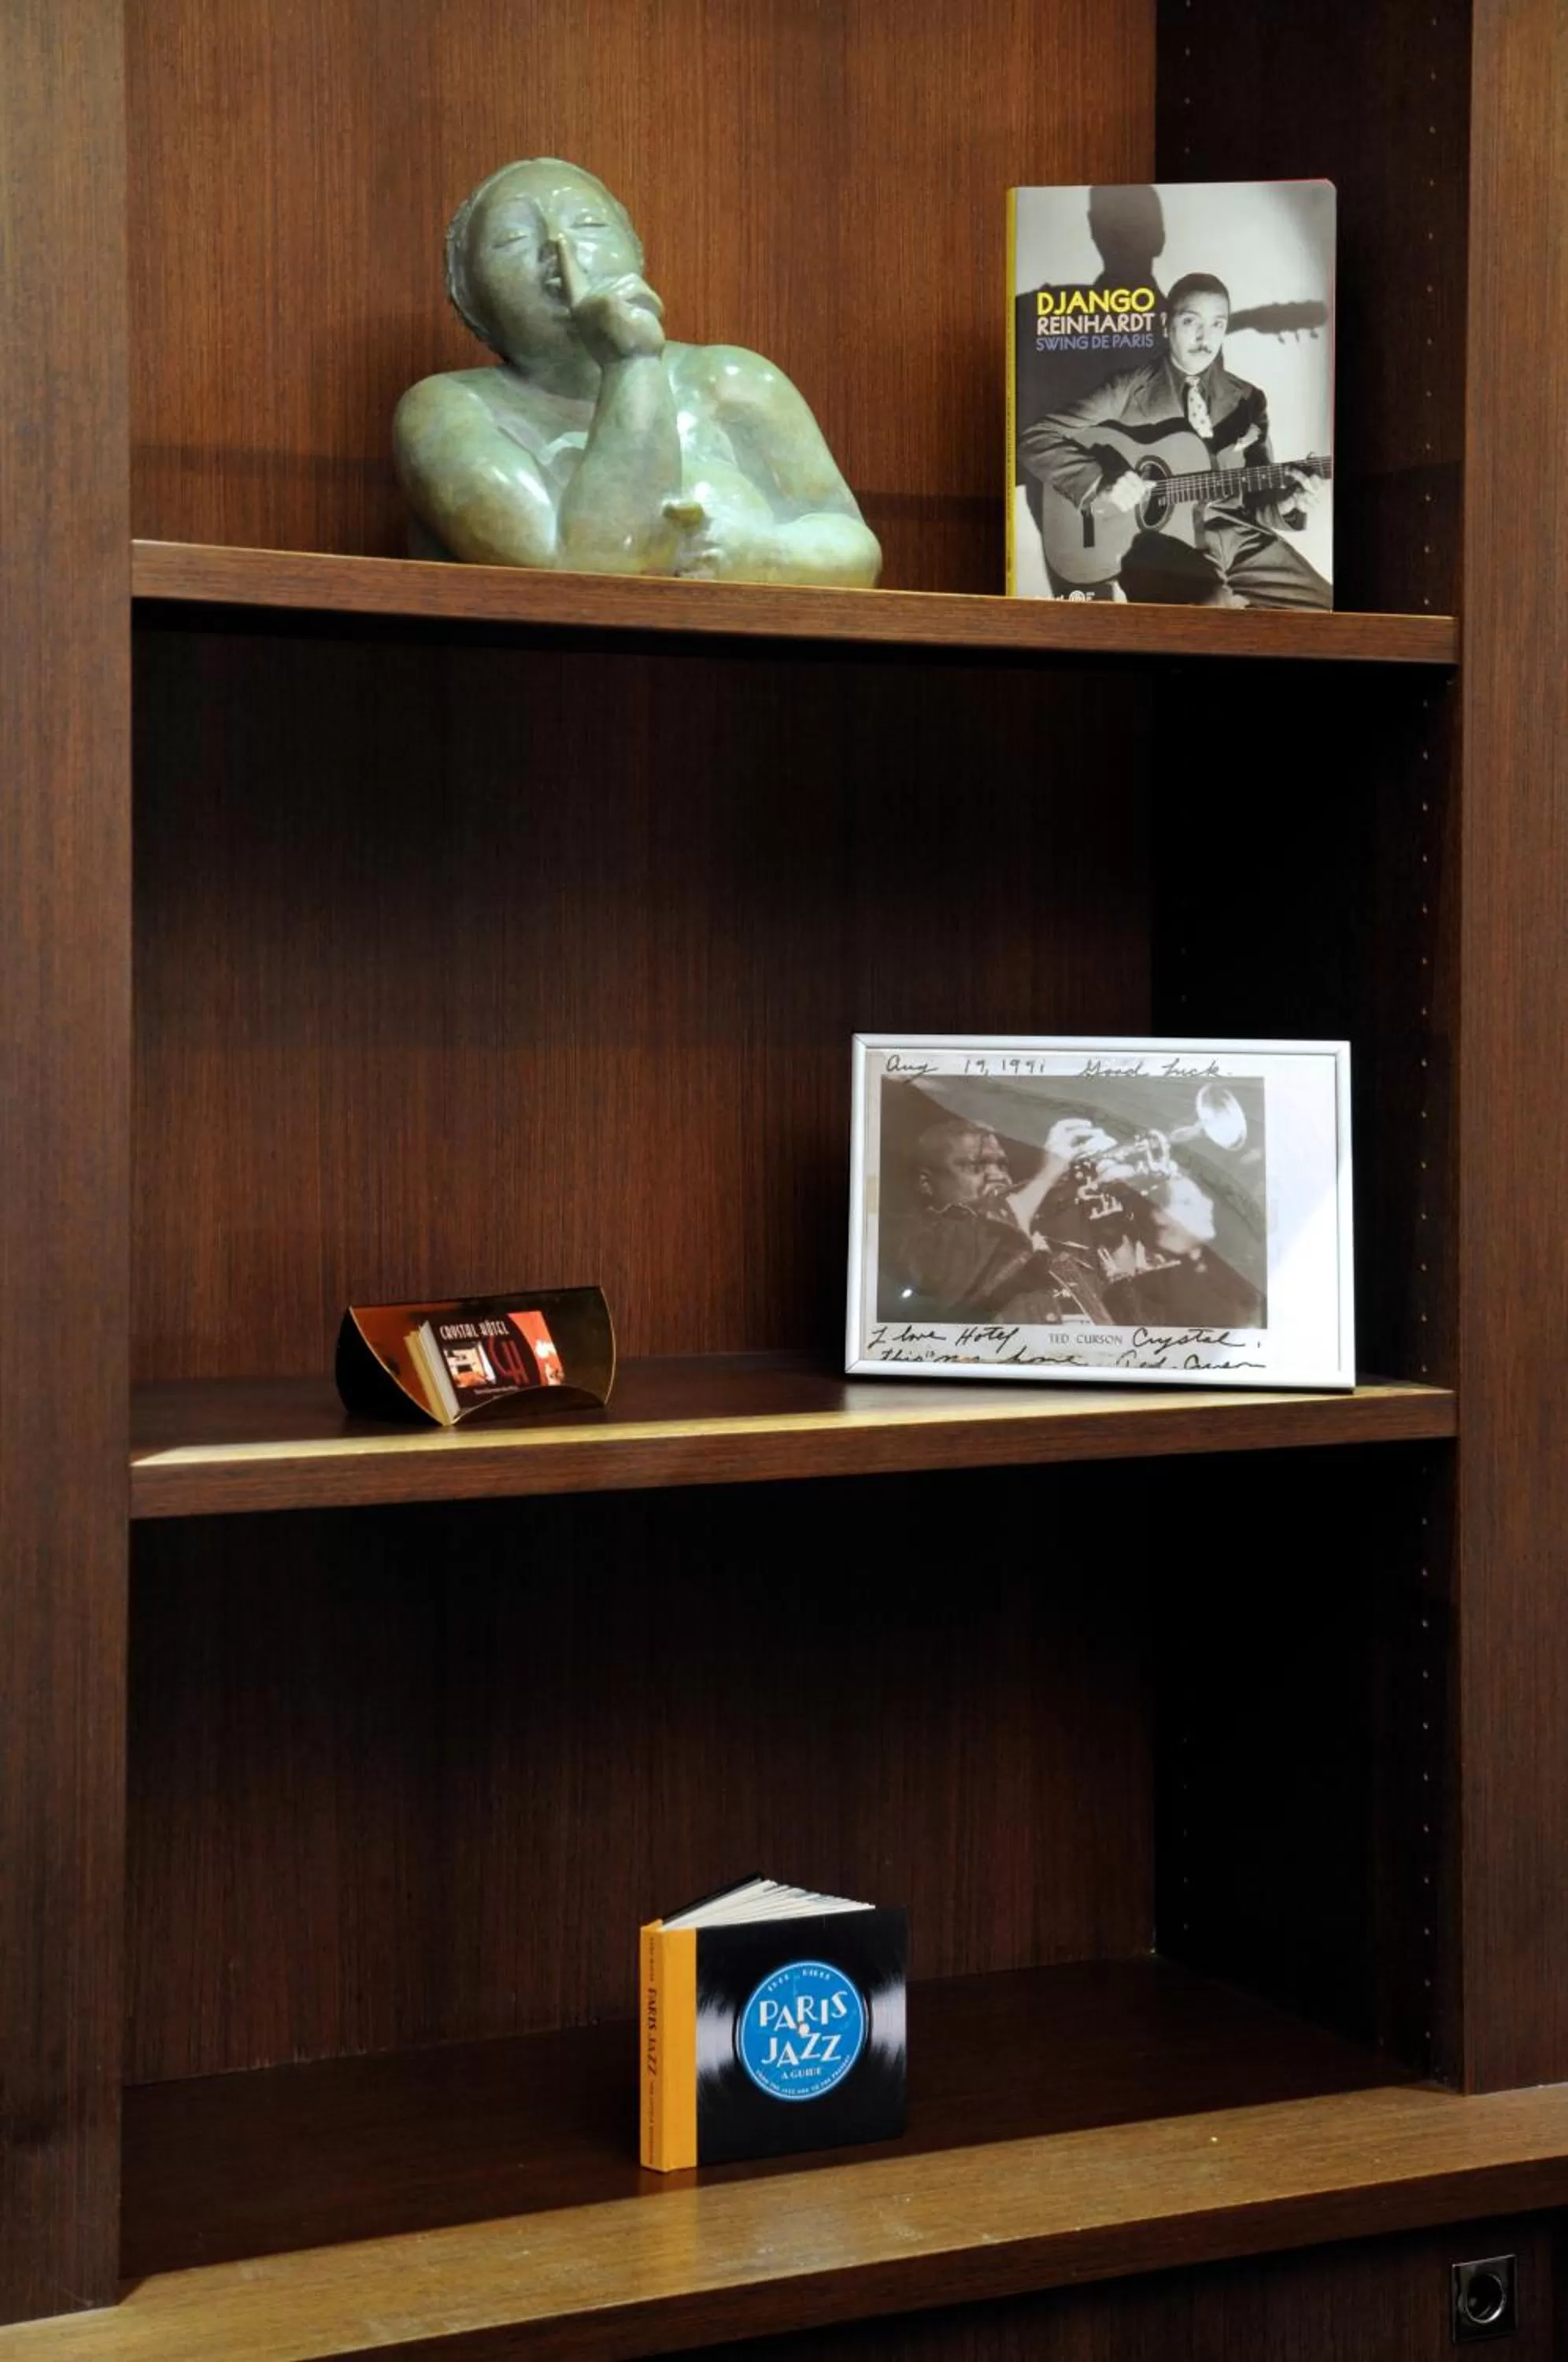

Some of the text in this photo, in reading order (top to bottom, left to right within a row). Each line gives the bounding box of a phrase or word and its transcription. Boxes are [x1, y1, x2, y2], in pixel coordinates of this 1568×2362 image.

[1037, 287, 1155, 315] DJANGO
[1037, 313, 1156, 335] REINHARDT
[1035, 333, 1155, 351] SWING DE PARIS
[893, 1324, 947, 1342] love
[955, 1326, 1020, 1354] Hotel
[1048, 1332, 1123, 1346] TED CURSON
[647, 1986, 657, 2031] PARIS
[759, 1990, 849, 2032] PARIS
[647, 2038, 657, 2076] JAZZ
[760, 2031, 842, 2068] JAZZ
